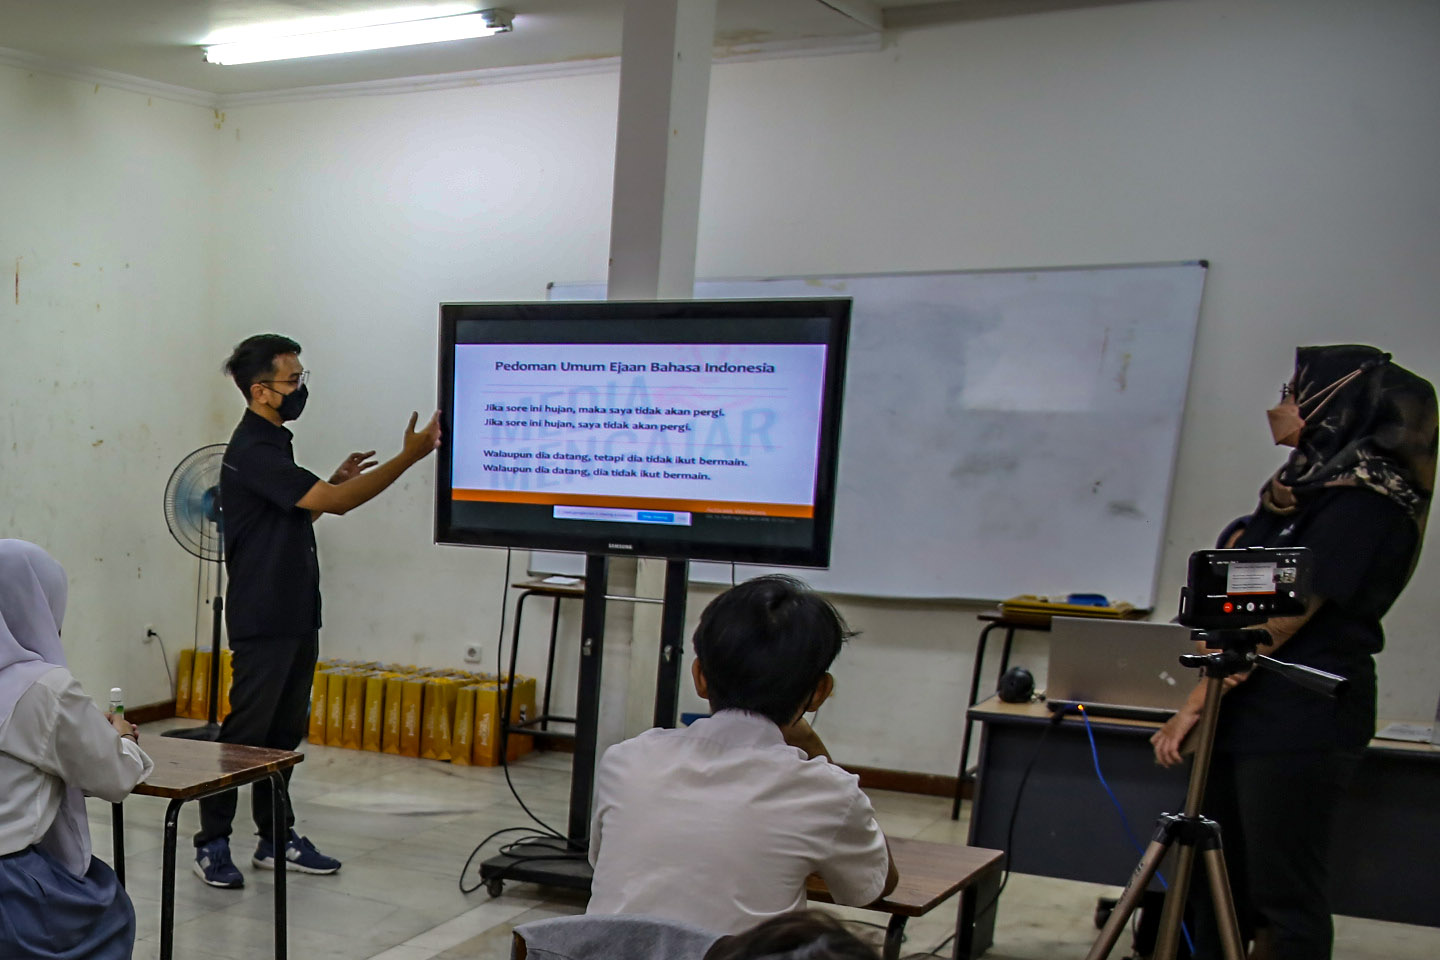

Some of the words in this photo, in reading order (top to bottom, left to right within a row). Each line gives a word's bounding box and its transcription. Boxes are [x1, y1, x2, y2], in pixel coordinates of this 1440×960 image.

[495, 361, 557, 372] Pedoman
[560, 361, 606, 372] Umum
[609, 361, 646, 375] Ejaan
[650, 361, 700, 373] Bahasa
[704, 362, 775, 374] Indonesia
[484, 403, 504, 412] Jika
[529, 404, 542, 413] ini
[544, 404, 576, 415] hujan,
[578, 405, 606, 414] maka
[608, 407, 633, 416] saya
[634, 406, 662, 415] tidak
[664, 407, 691, 416] akan
[693, 408, 725, 419] pergi.
[484, 418, 503, 427] Jika
[529, 419, 542, 427] ini
[544, 419, 576, 429] hujan,
[577, 422, 601, 430] saya
[603, 421, 629, 430] tidak
[631, 422, 658, 430] akan
[660, 422, 692, 433] pergi.
[483, 449, 533, 460] Walaupun
[535, 451, 551, 459] dia
[552, 451, 592, 463] datang,
[593, 453, 624, 463] tetapi
[626, 454, 643, 463] dia
[645, 455, 672, 464] tidak
[674, 456, 696, 465] ikut
[698, 456, 748, 467] bermain.
[482, 463, 532, 474] Walaupun
[534, 465, 550, 474] dia
[551, 466, 591, 477] datang,
[592, 468, 609, 477] dia
[611, 469, 637, 477] tidak
[640, 469, 661, 478] ikut
[662, 470, 711, 481] bermain.
